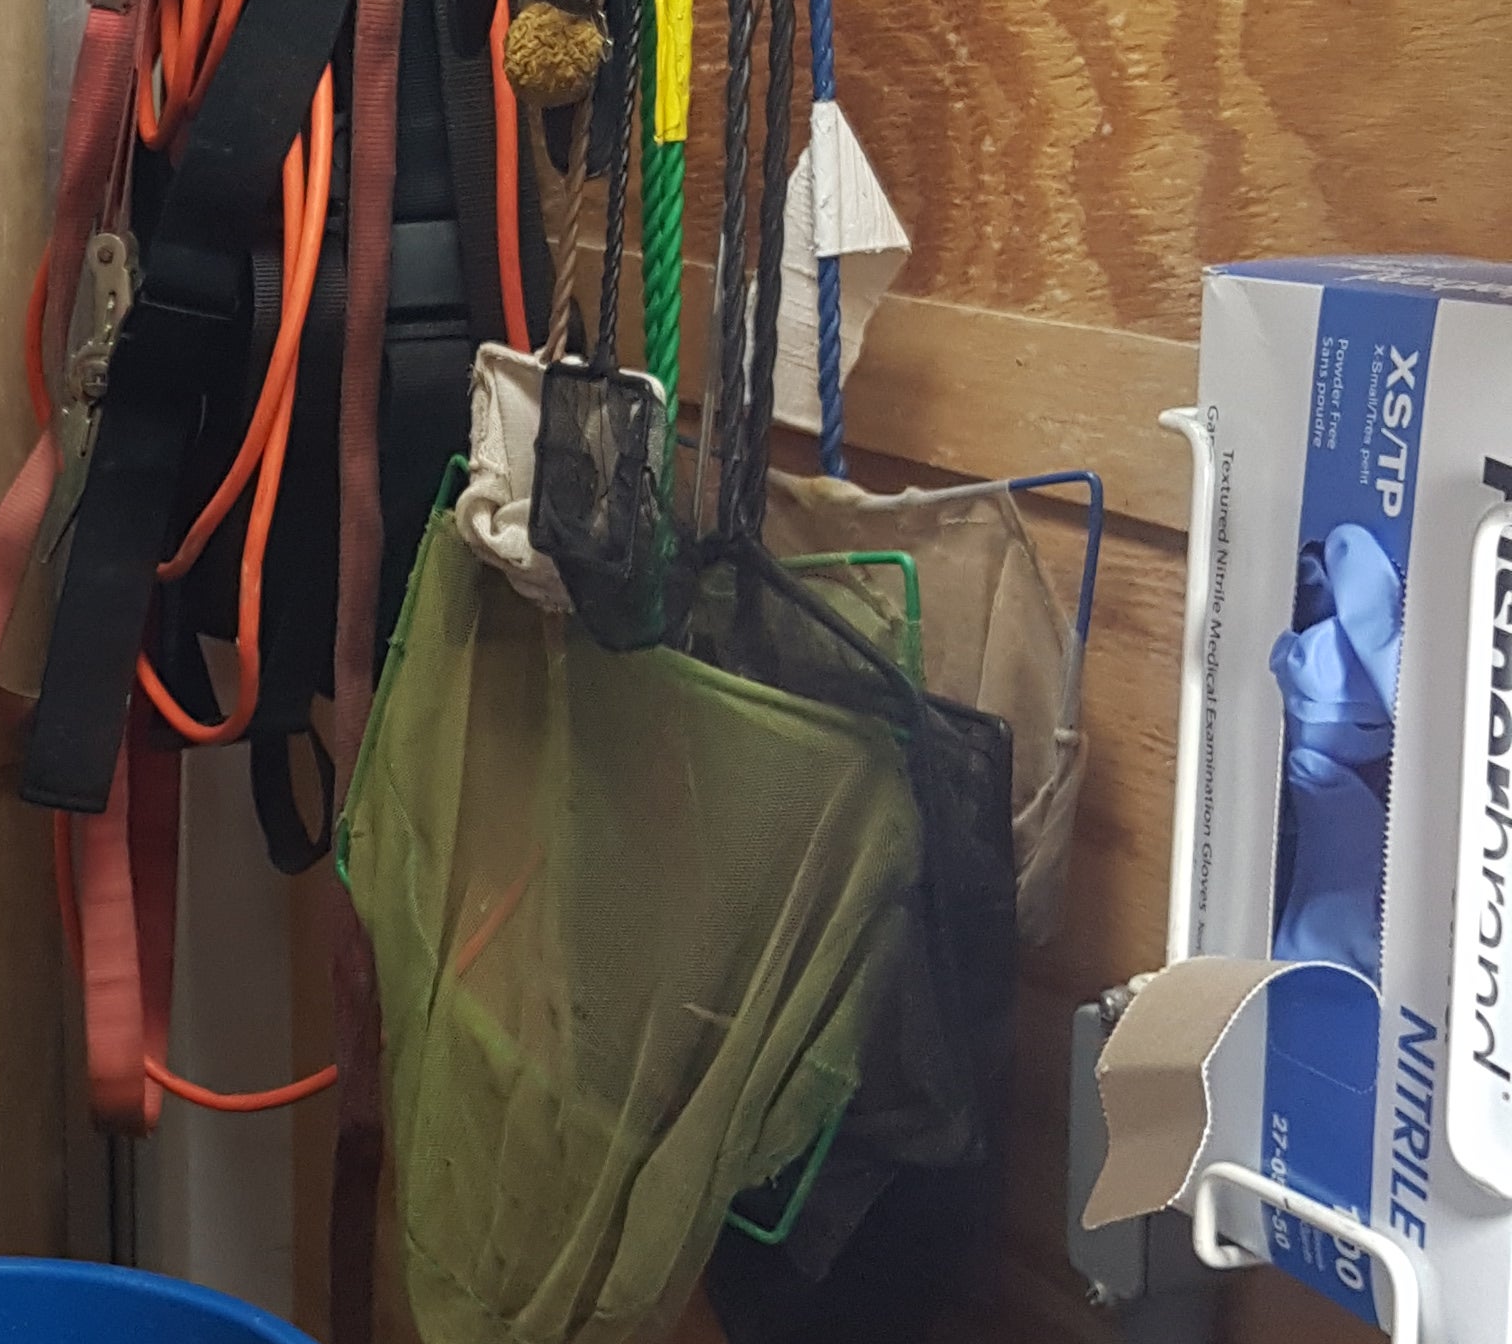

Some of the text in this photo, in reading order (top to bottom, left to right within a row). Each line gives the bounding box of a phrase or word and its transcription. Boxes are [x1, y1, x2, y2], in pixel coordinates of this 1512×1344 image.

[1312, 336, 1334, 449] Sans poudre
[1326, 338, 1350, 450] Powder Free
[1374, 345, 1420, 517] XS/TP
[1216, 449, 1235, 544] Textured
[1211, 548, 1229, 614] Nitrile
[1205, 617, 1223, 702] Medical
[1201, 707, 1218, 837] Examination
[1197, 842, 1213, 912] Gloves
[1389, 1004, 1438, 1251] NITRILE
